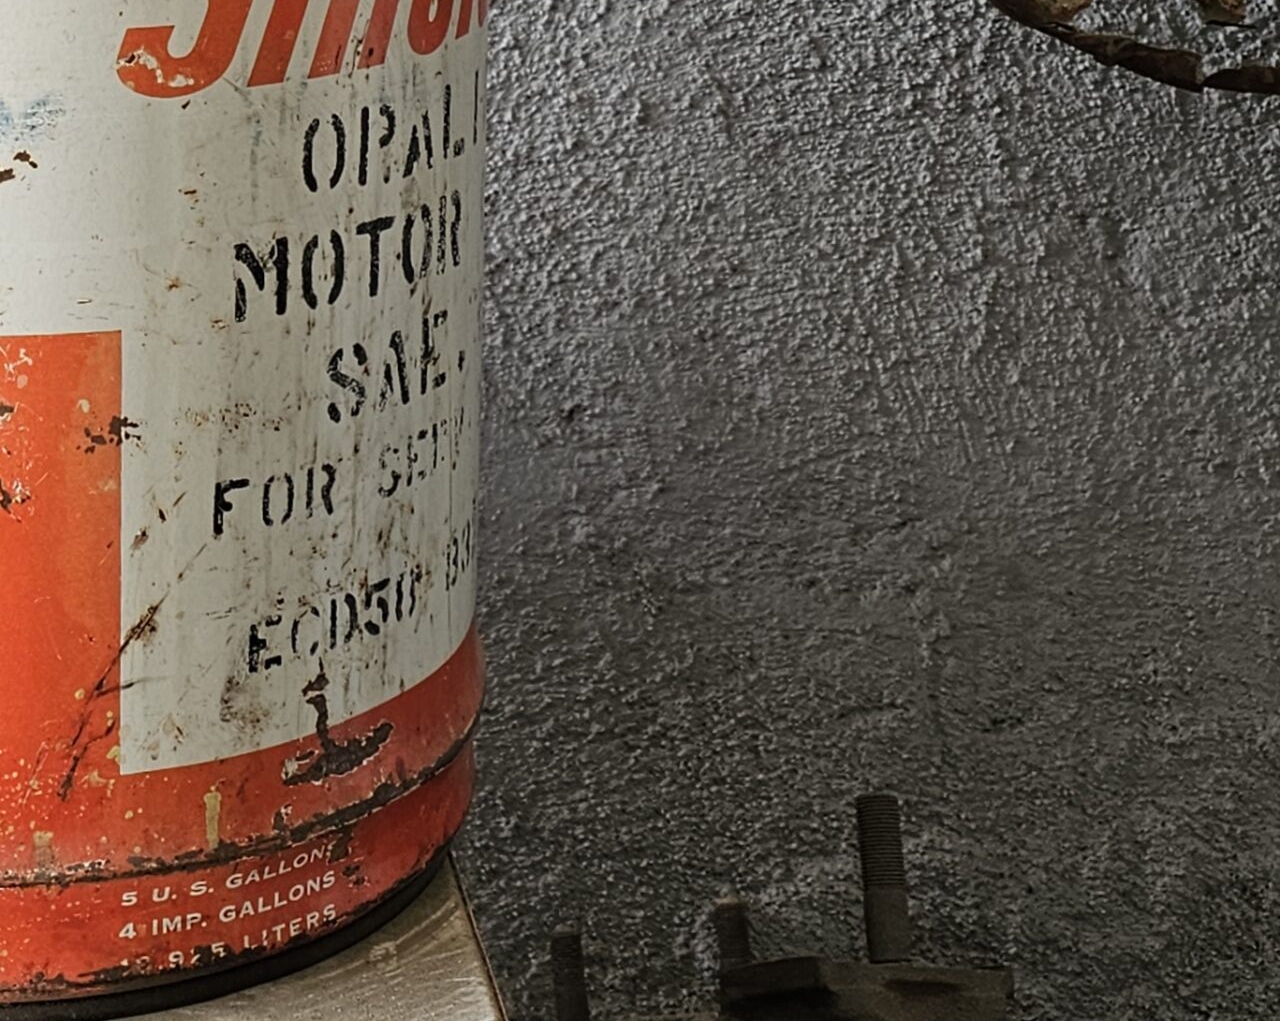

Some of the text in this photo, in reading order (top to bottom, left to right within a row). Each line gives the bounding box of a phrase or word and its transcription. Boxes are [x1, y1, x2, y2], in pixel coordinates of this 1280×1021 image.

[233, 189, 462, 323] MOTOR
[212, 463, 338, 536] FOR
[118, 870, 337, 940] 4 IMP. GALLONS
[120, 890, 138, 907] 5
[151, 885, 177, 903] U.
[189, 880, 214, 897] S.
[243, 903, 337, 950] LITERS
